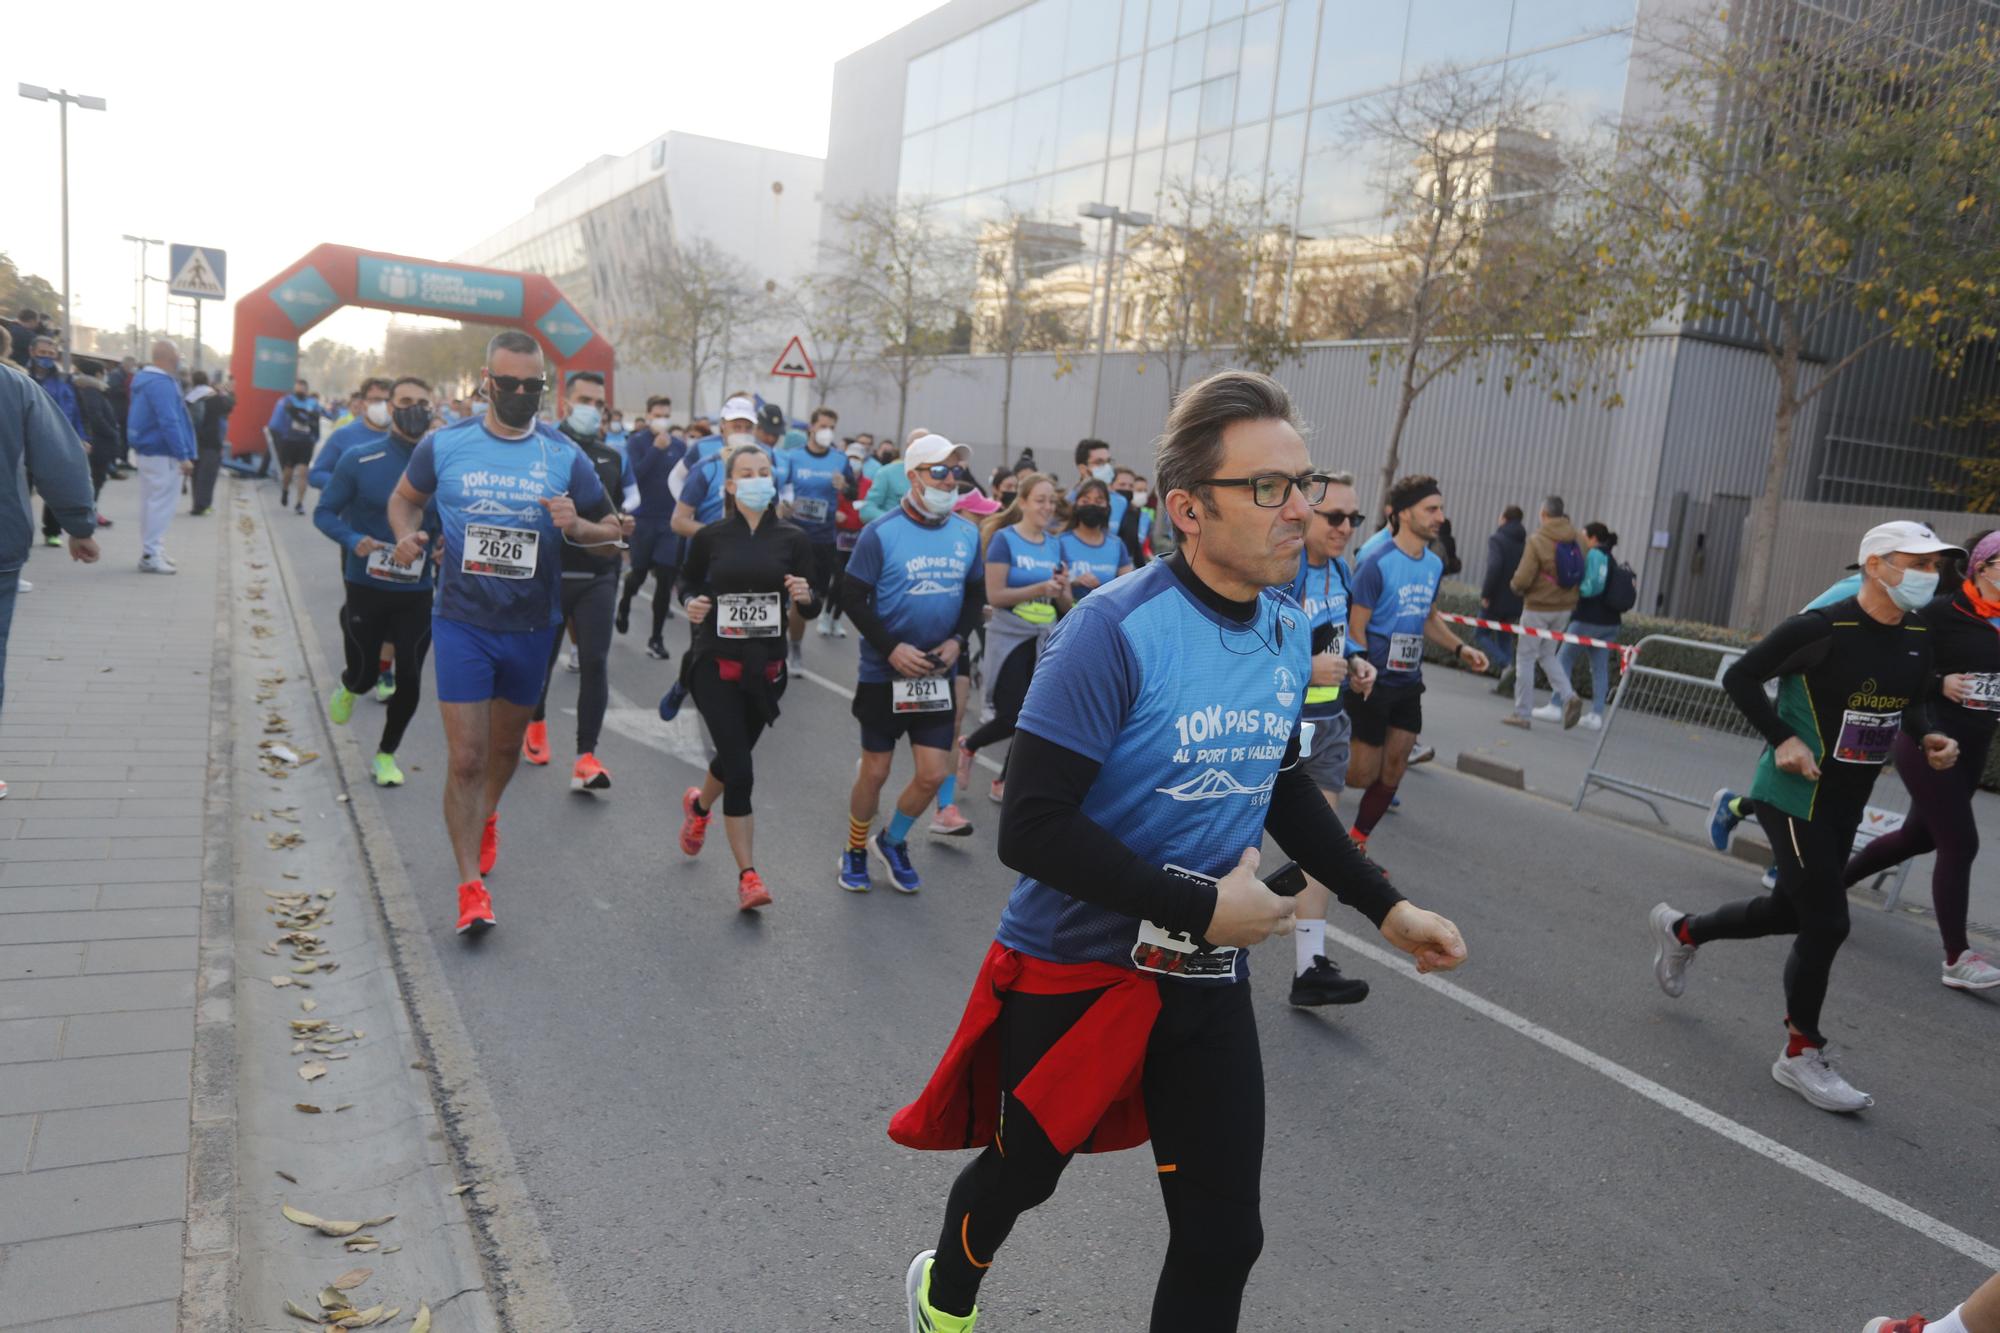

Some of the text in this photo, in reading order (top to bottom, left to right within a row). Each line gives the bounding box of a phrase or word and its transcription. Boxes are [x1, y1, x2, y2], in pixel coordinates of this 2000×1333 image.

[462, 471, 545, 495] 10K PAS RAS
[479, 540, 522, 560] 2626
[730, 606, 767, 621] 2625
[907, 681, 937, 696] 2621
[1174, 704, 1293, 747] 10K PAS RAS
[1172, 748, 1190, 763] AL
[1195, 748, 1228, 763] PORT
[1231, 747, 1246, 762] DE
